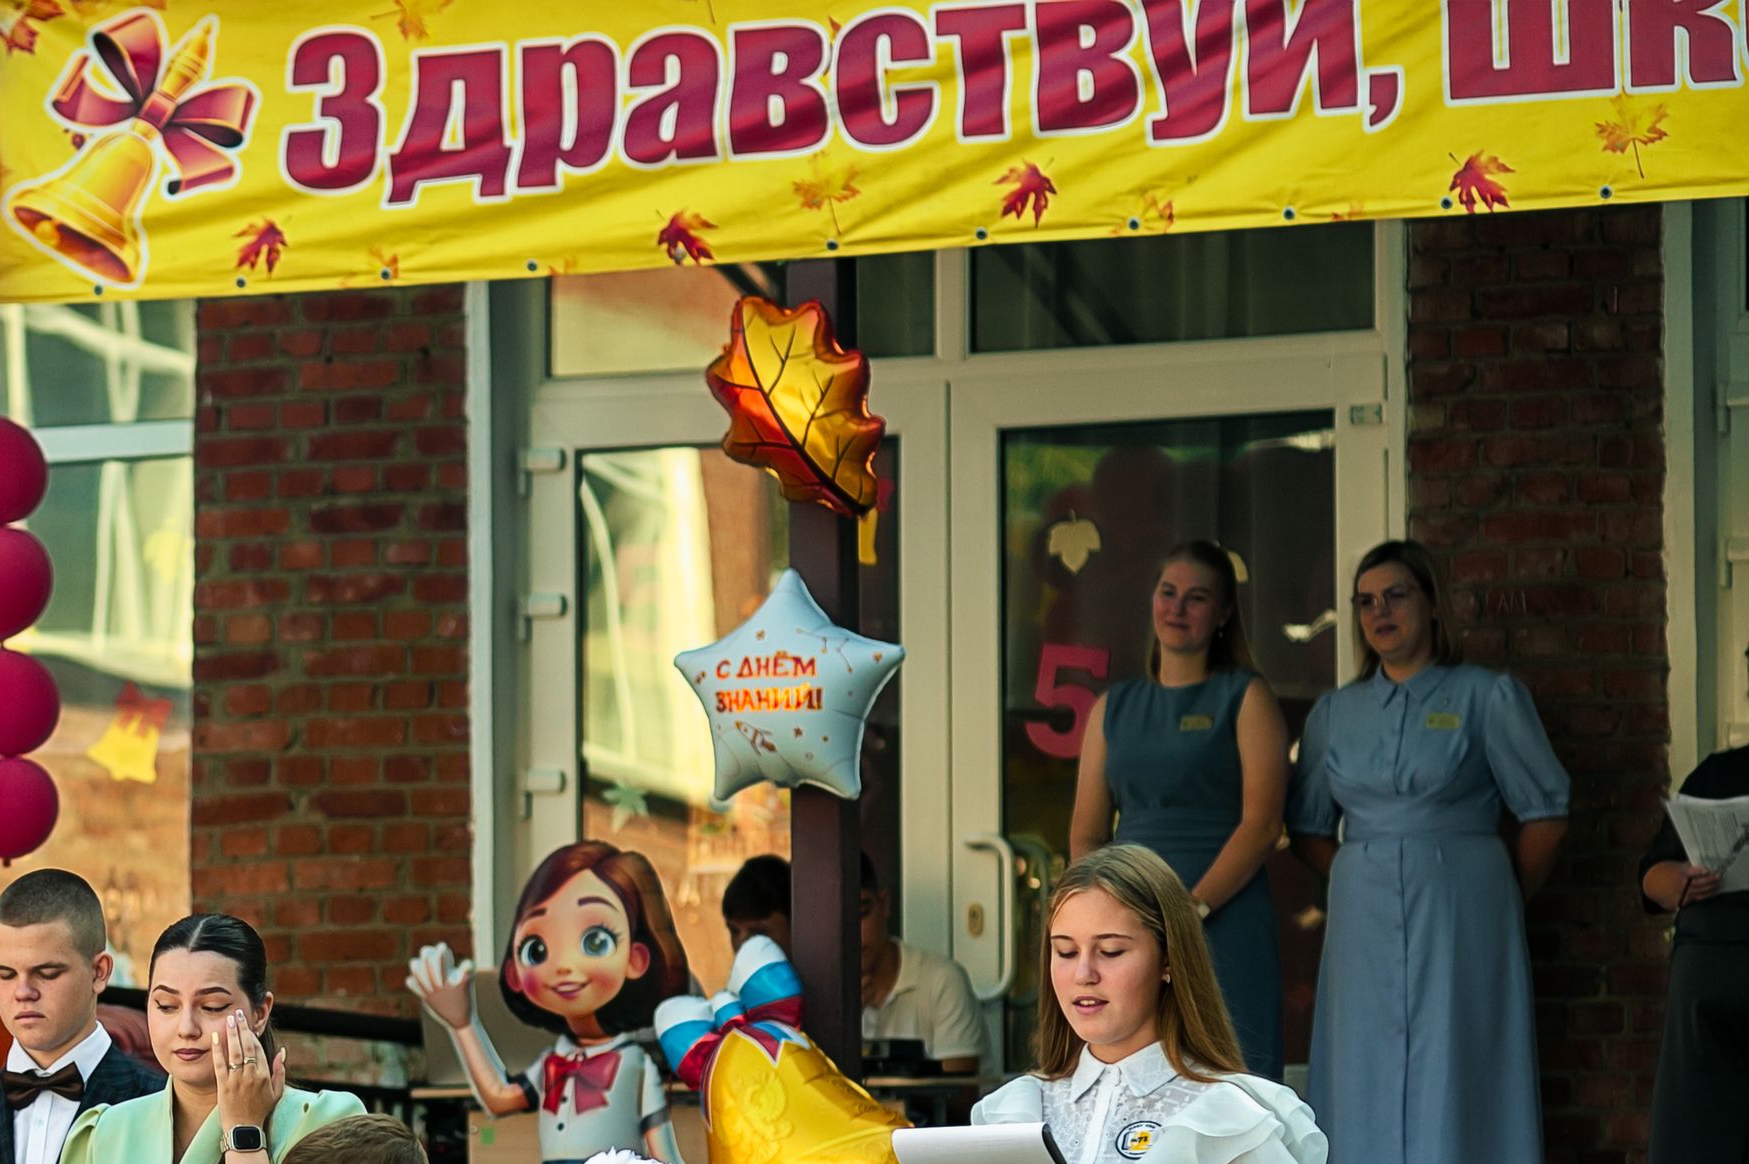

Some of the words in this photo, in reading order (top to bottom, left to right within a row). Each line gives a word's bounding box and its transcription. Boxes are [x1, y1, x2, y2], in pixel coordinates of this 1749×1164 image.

[715, 659, 731, 679] С
[736, 650, 818, 679] ДНЁМ
[715, 681, 824, 714] ЗНАНИЙ!
[1025, 642, 1110, 759] 5
